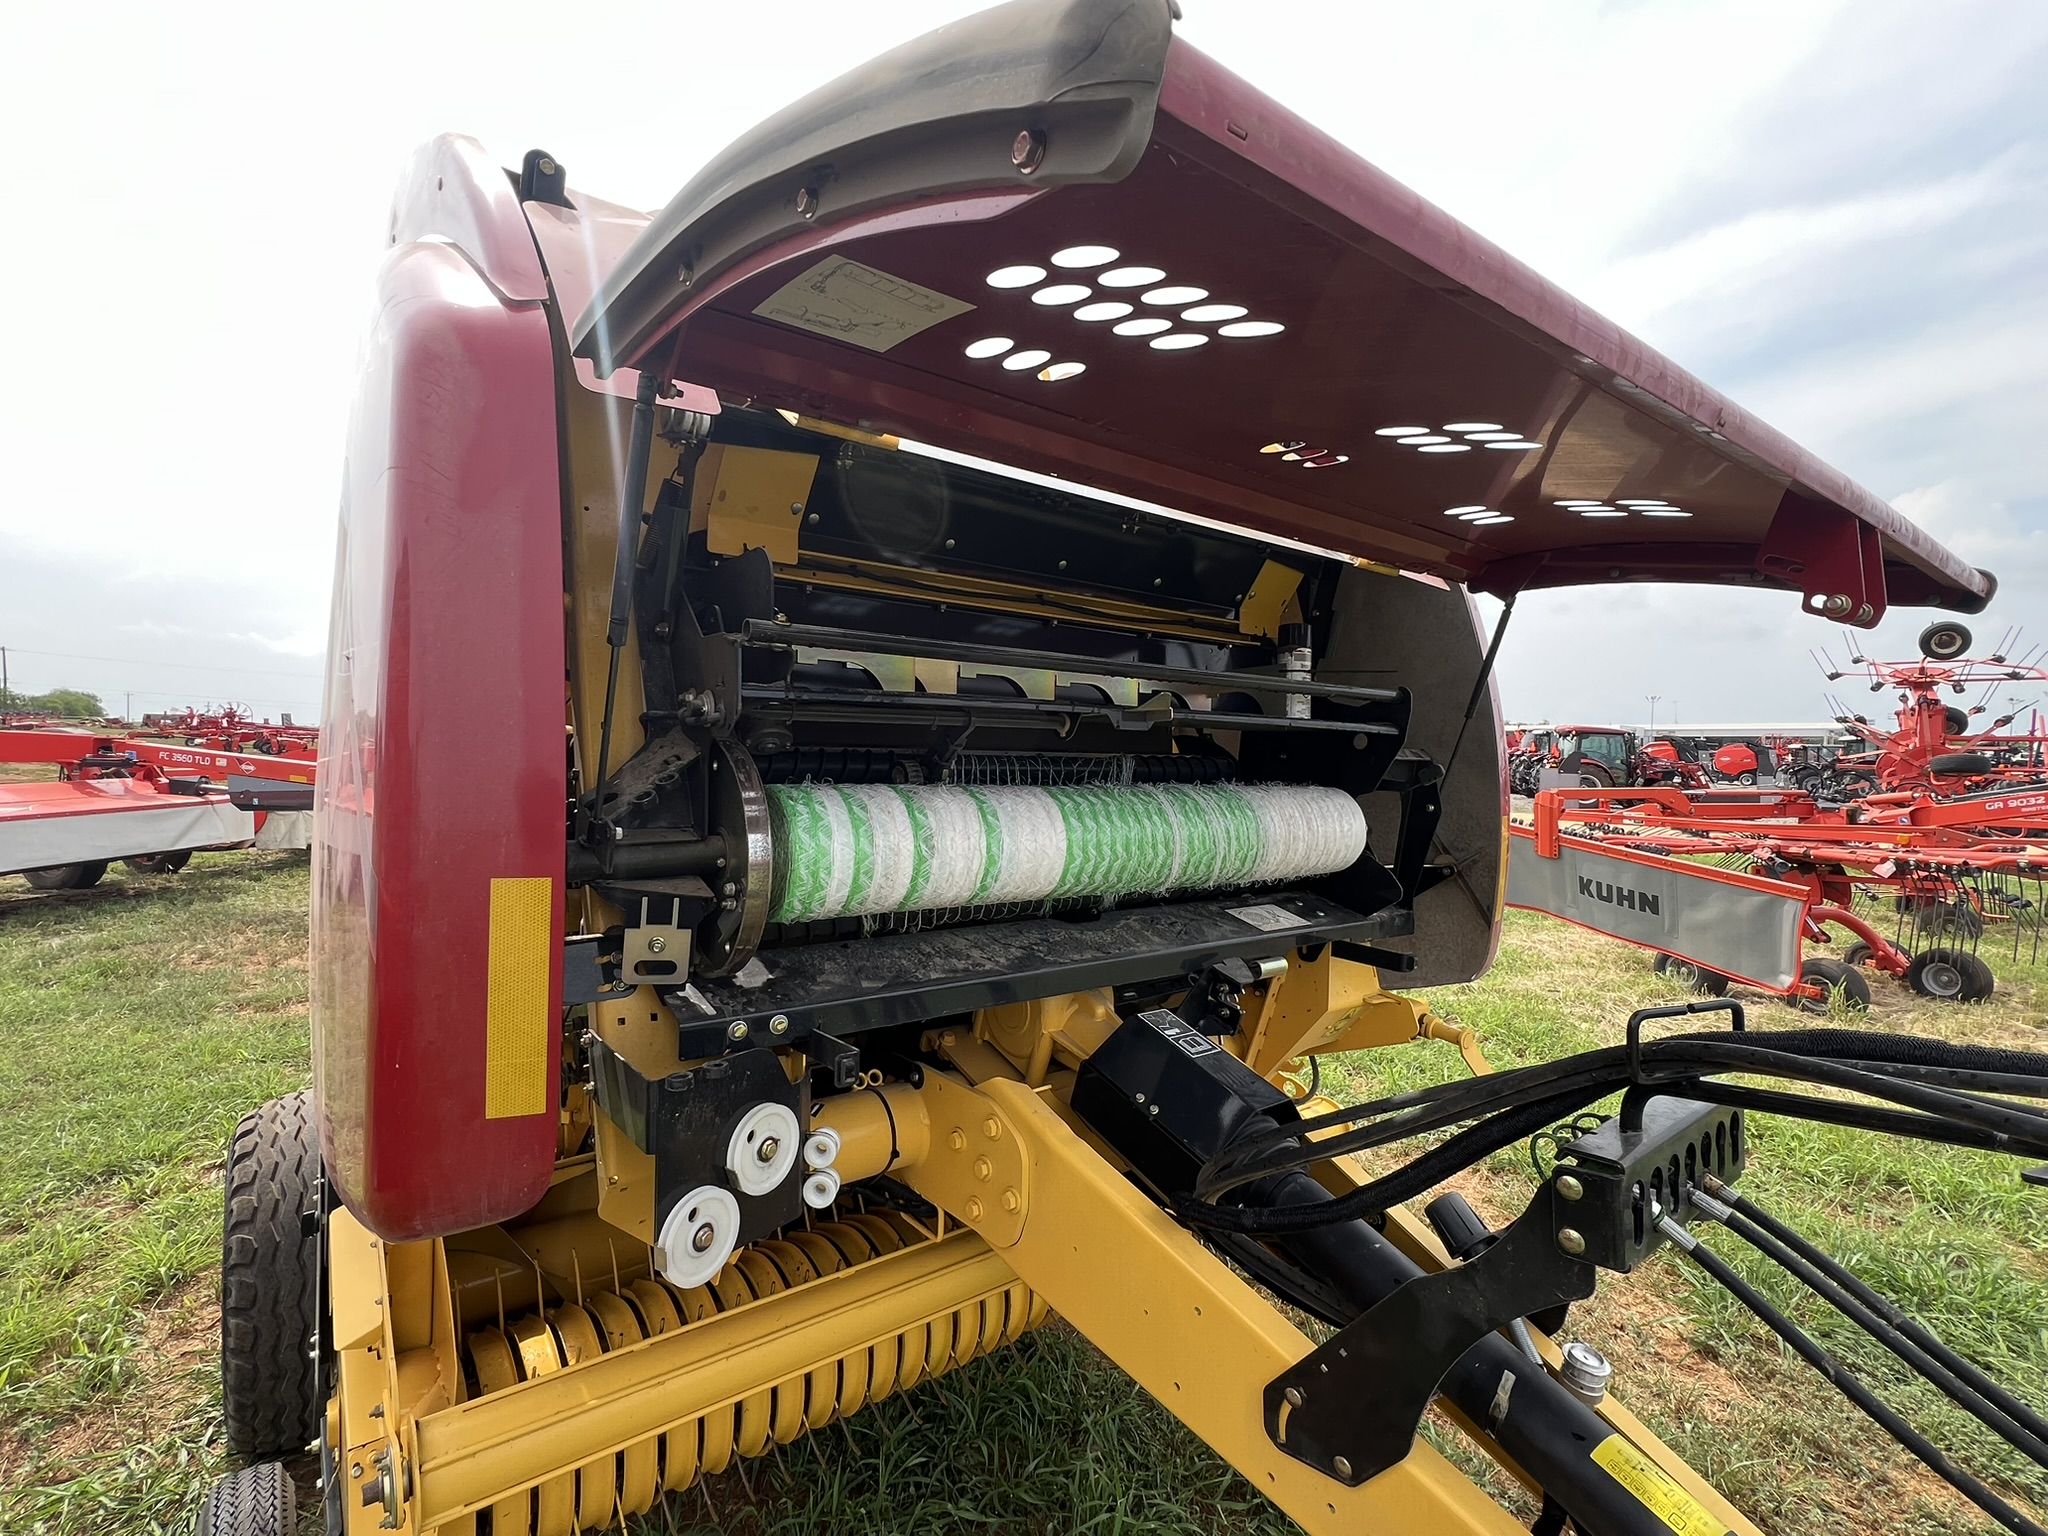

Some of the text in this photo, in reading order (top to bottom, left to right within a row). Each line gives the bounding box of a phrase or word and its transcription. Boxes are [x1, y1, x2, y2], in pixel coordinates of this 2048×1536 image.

[159, 751, 170, 760] FC
[171, 752, 193, 763] 3560
[194, 756, 211, 765] TLD
[1985, 796, 2046, 810] GA 9032
[1578, 875, 1660, 916] KUHN
